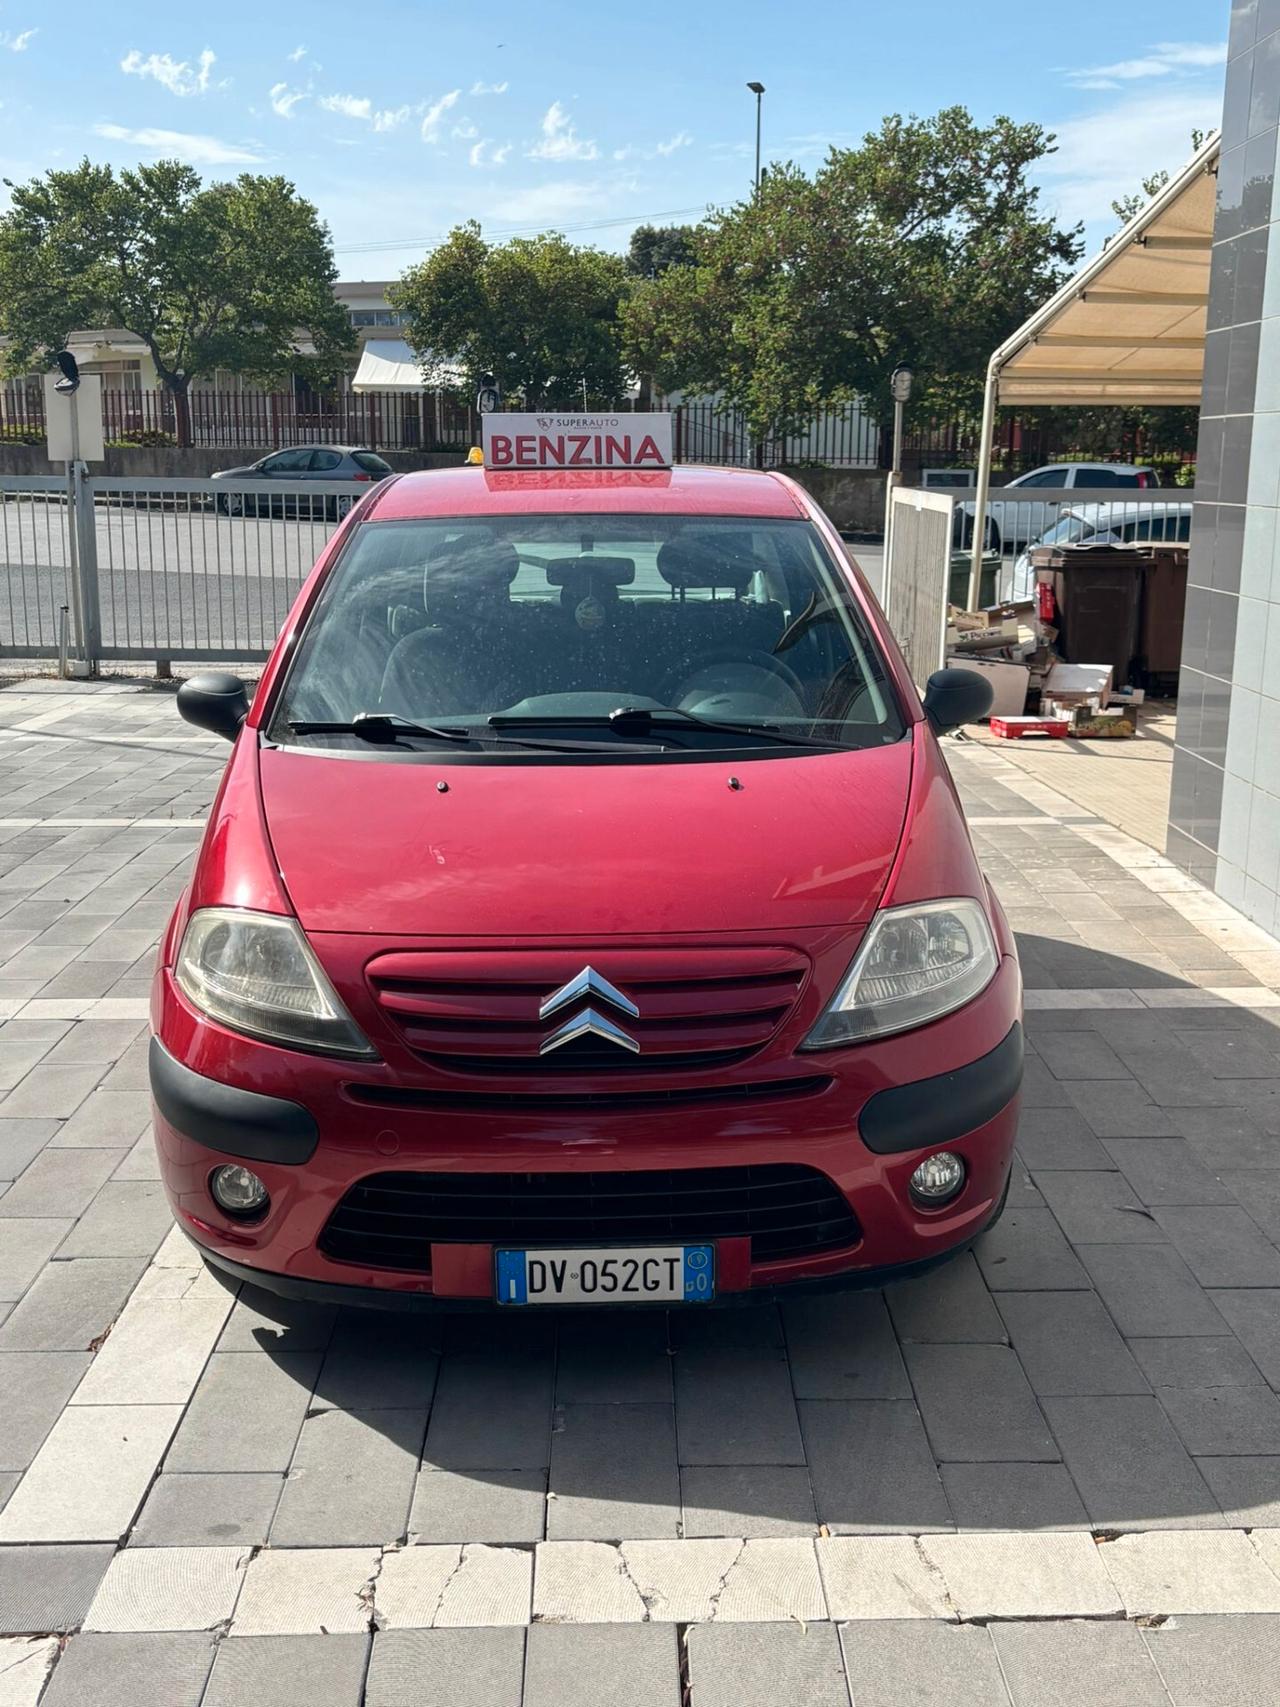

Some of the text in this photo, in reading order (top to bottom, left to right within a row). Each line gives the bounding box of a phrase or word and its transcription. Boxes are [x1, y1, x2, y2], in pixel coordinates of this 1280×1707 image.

[557, 418, 619, 427] SUPERAUTO
[491, 435, 665, 465] BENZINA
[528, 1259, 567, 1293] DV
[580, 1258, 681, 1293] 052GT
